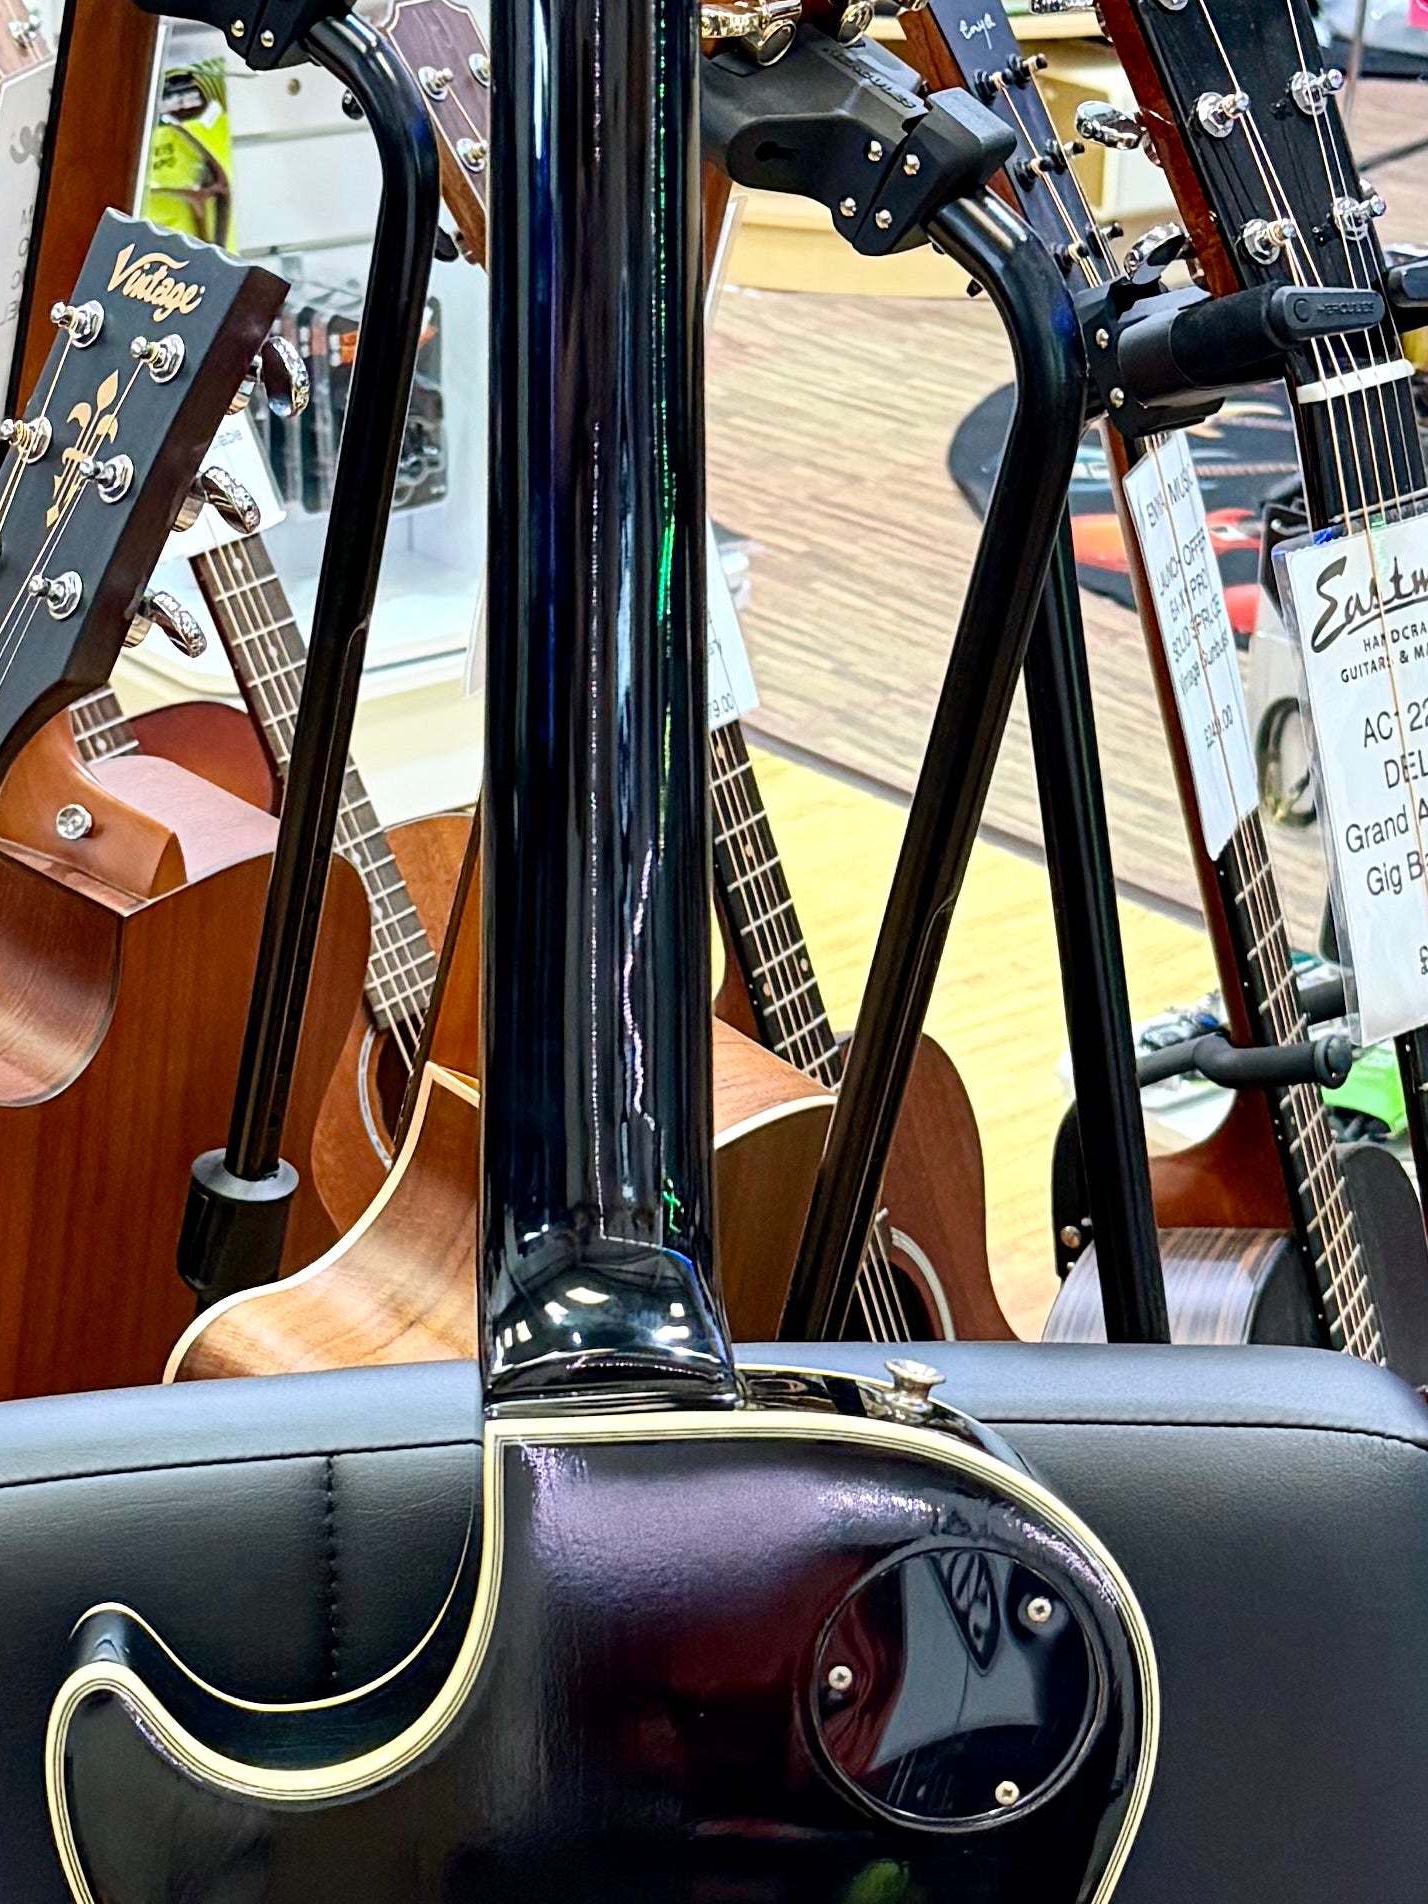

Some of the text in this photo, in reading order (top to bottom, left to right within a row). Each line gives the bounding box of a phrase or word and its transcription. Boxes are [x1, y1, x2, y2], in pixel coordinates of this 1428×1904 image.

[106, 242, 206, 324] Vintage
[1340, 652, 1395, 685] GUITARS
[1397, 647, 1410, 665] &
[1344, 806, 1411, 856] Grand
[1365, 857, 1405, 900] Gig
